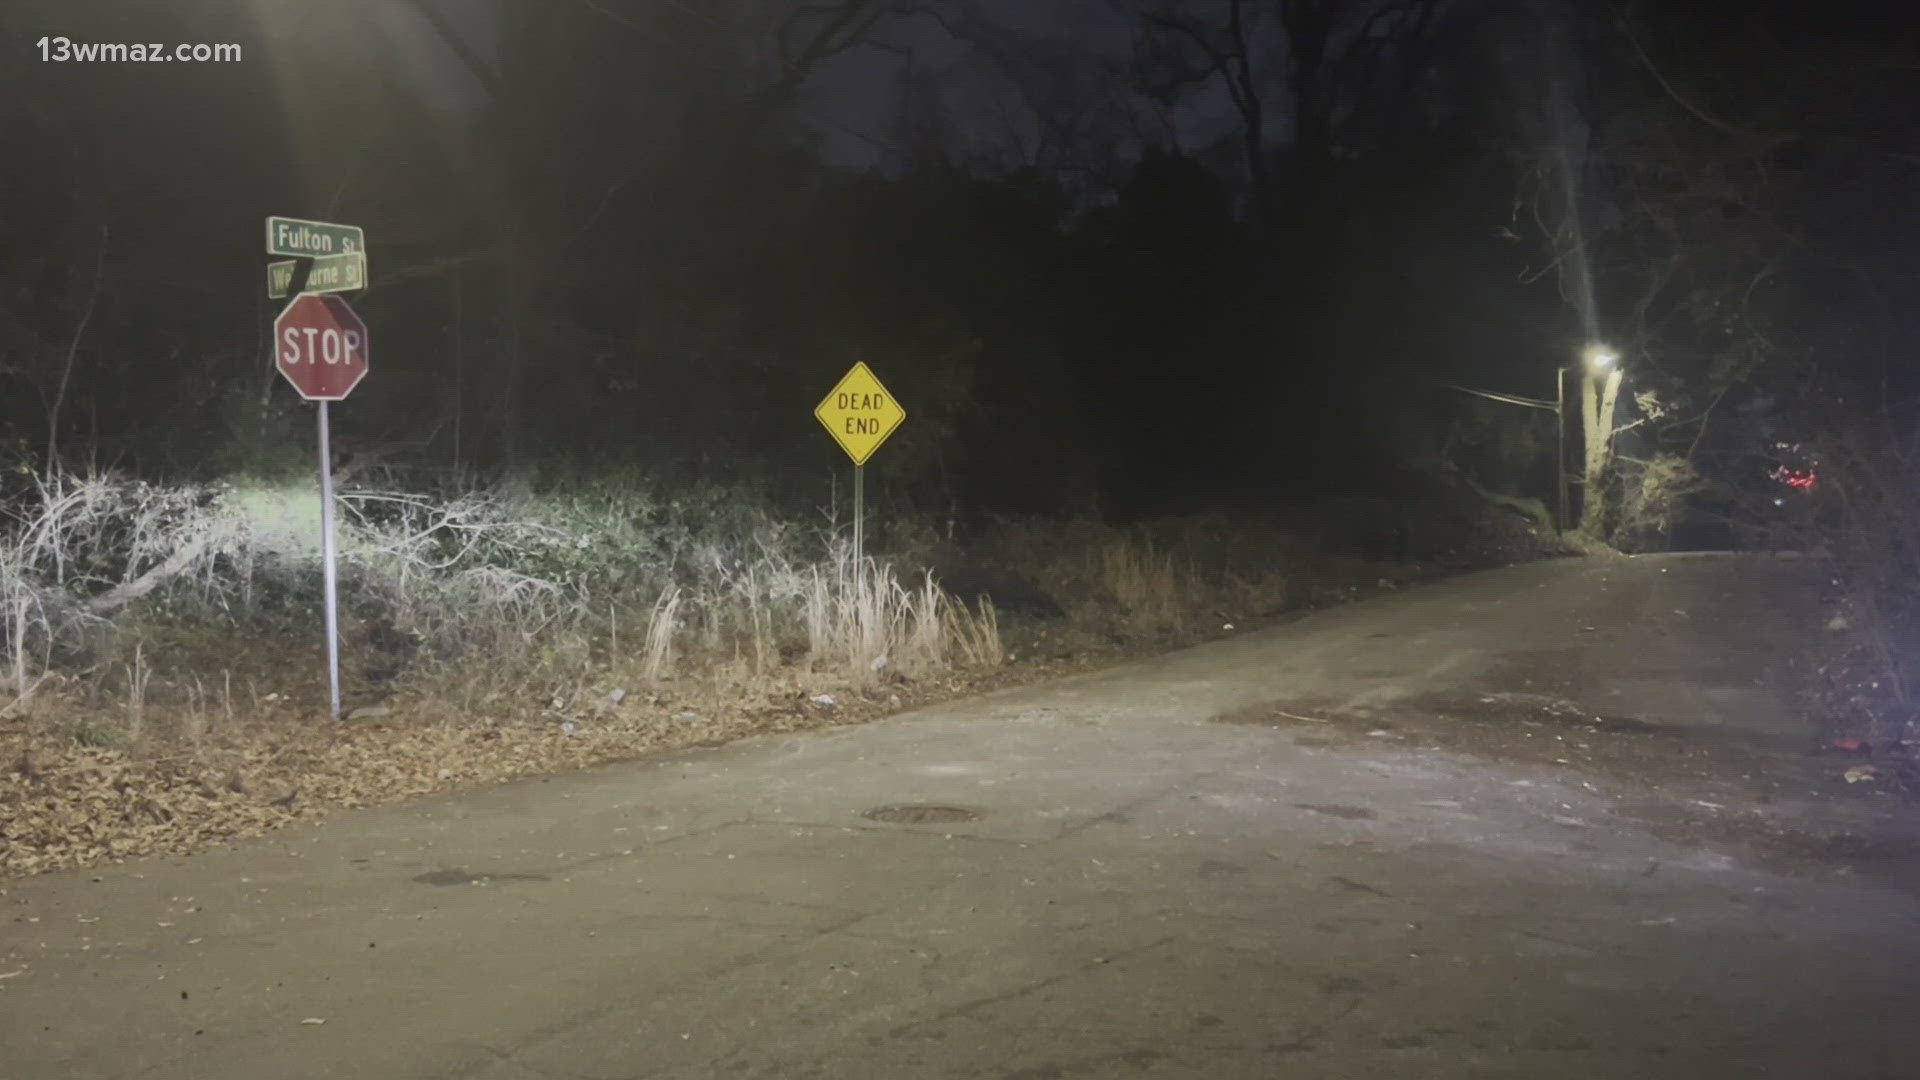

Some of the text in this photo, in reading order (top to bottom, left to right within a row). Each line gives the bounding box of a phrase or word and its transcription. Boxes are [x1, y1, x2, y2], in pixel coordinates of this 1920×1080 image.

[279, 224, 332, 252] Fulton
[283, 327, 360, 365] STOP
[838, 392, 884, 411] DEAD
[845, 417, 880, 436] END
